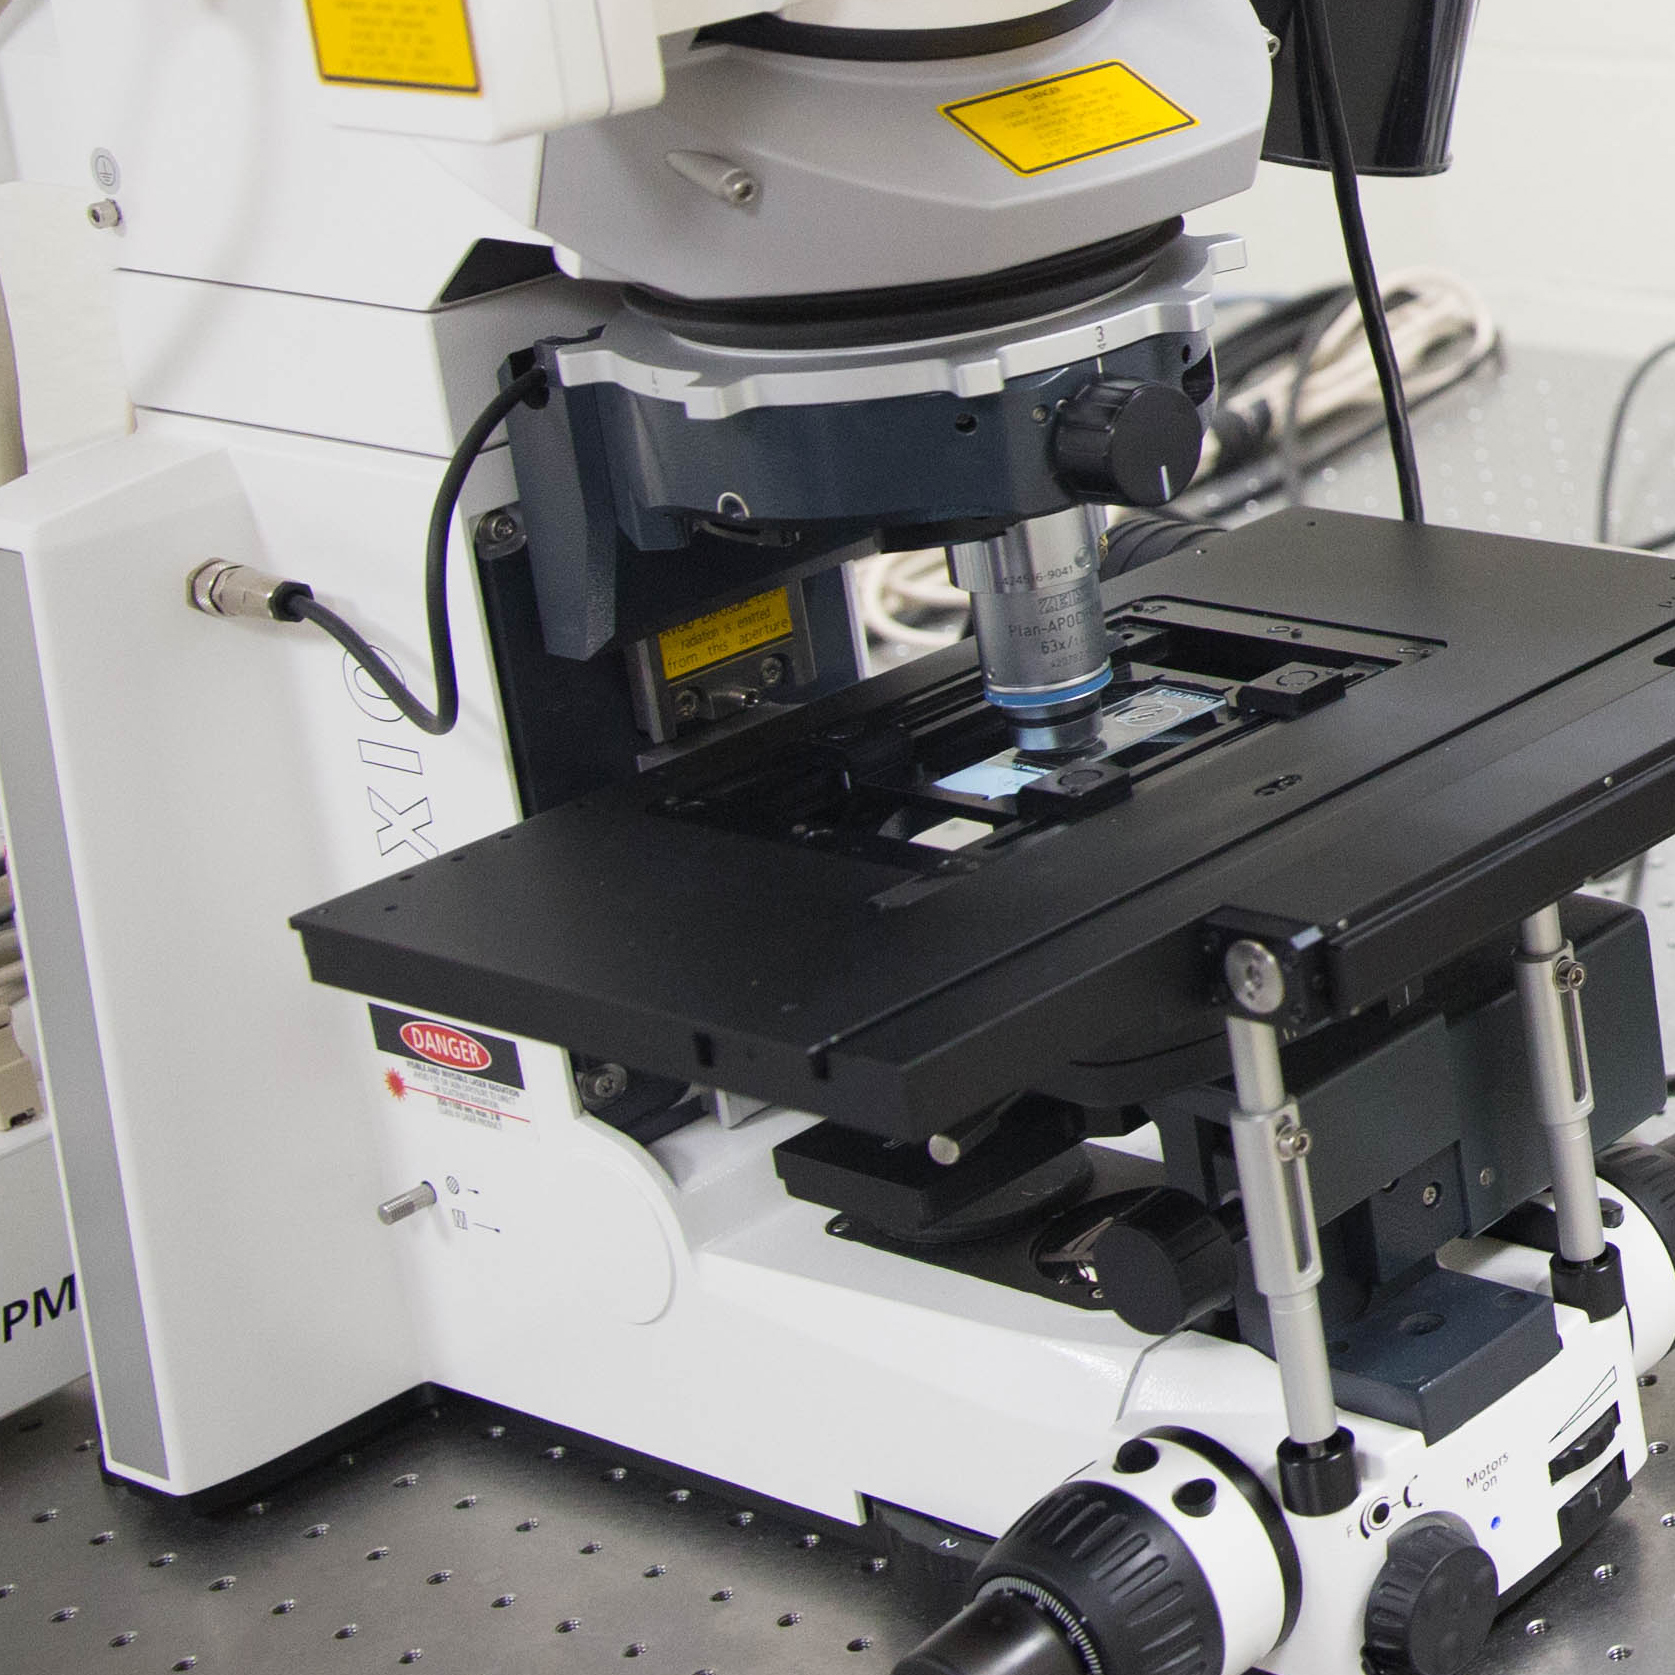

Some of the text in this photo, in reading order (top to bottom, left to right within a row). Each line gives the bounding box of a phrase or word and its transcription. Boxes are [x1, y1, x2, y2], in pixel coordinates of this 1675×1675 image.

[1095, 325, 1105, 343] 3
[736, 606, 772, 630] emitted
[667, 618, 790, 673] from this aperture
[410, 1026, 482, 1066] DANGER
[3, 1273, 76, 1344] PM
[1466, 1451, 1509, 1490] Motors
[1482, 1475, 1498, 1492] on
